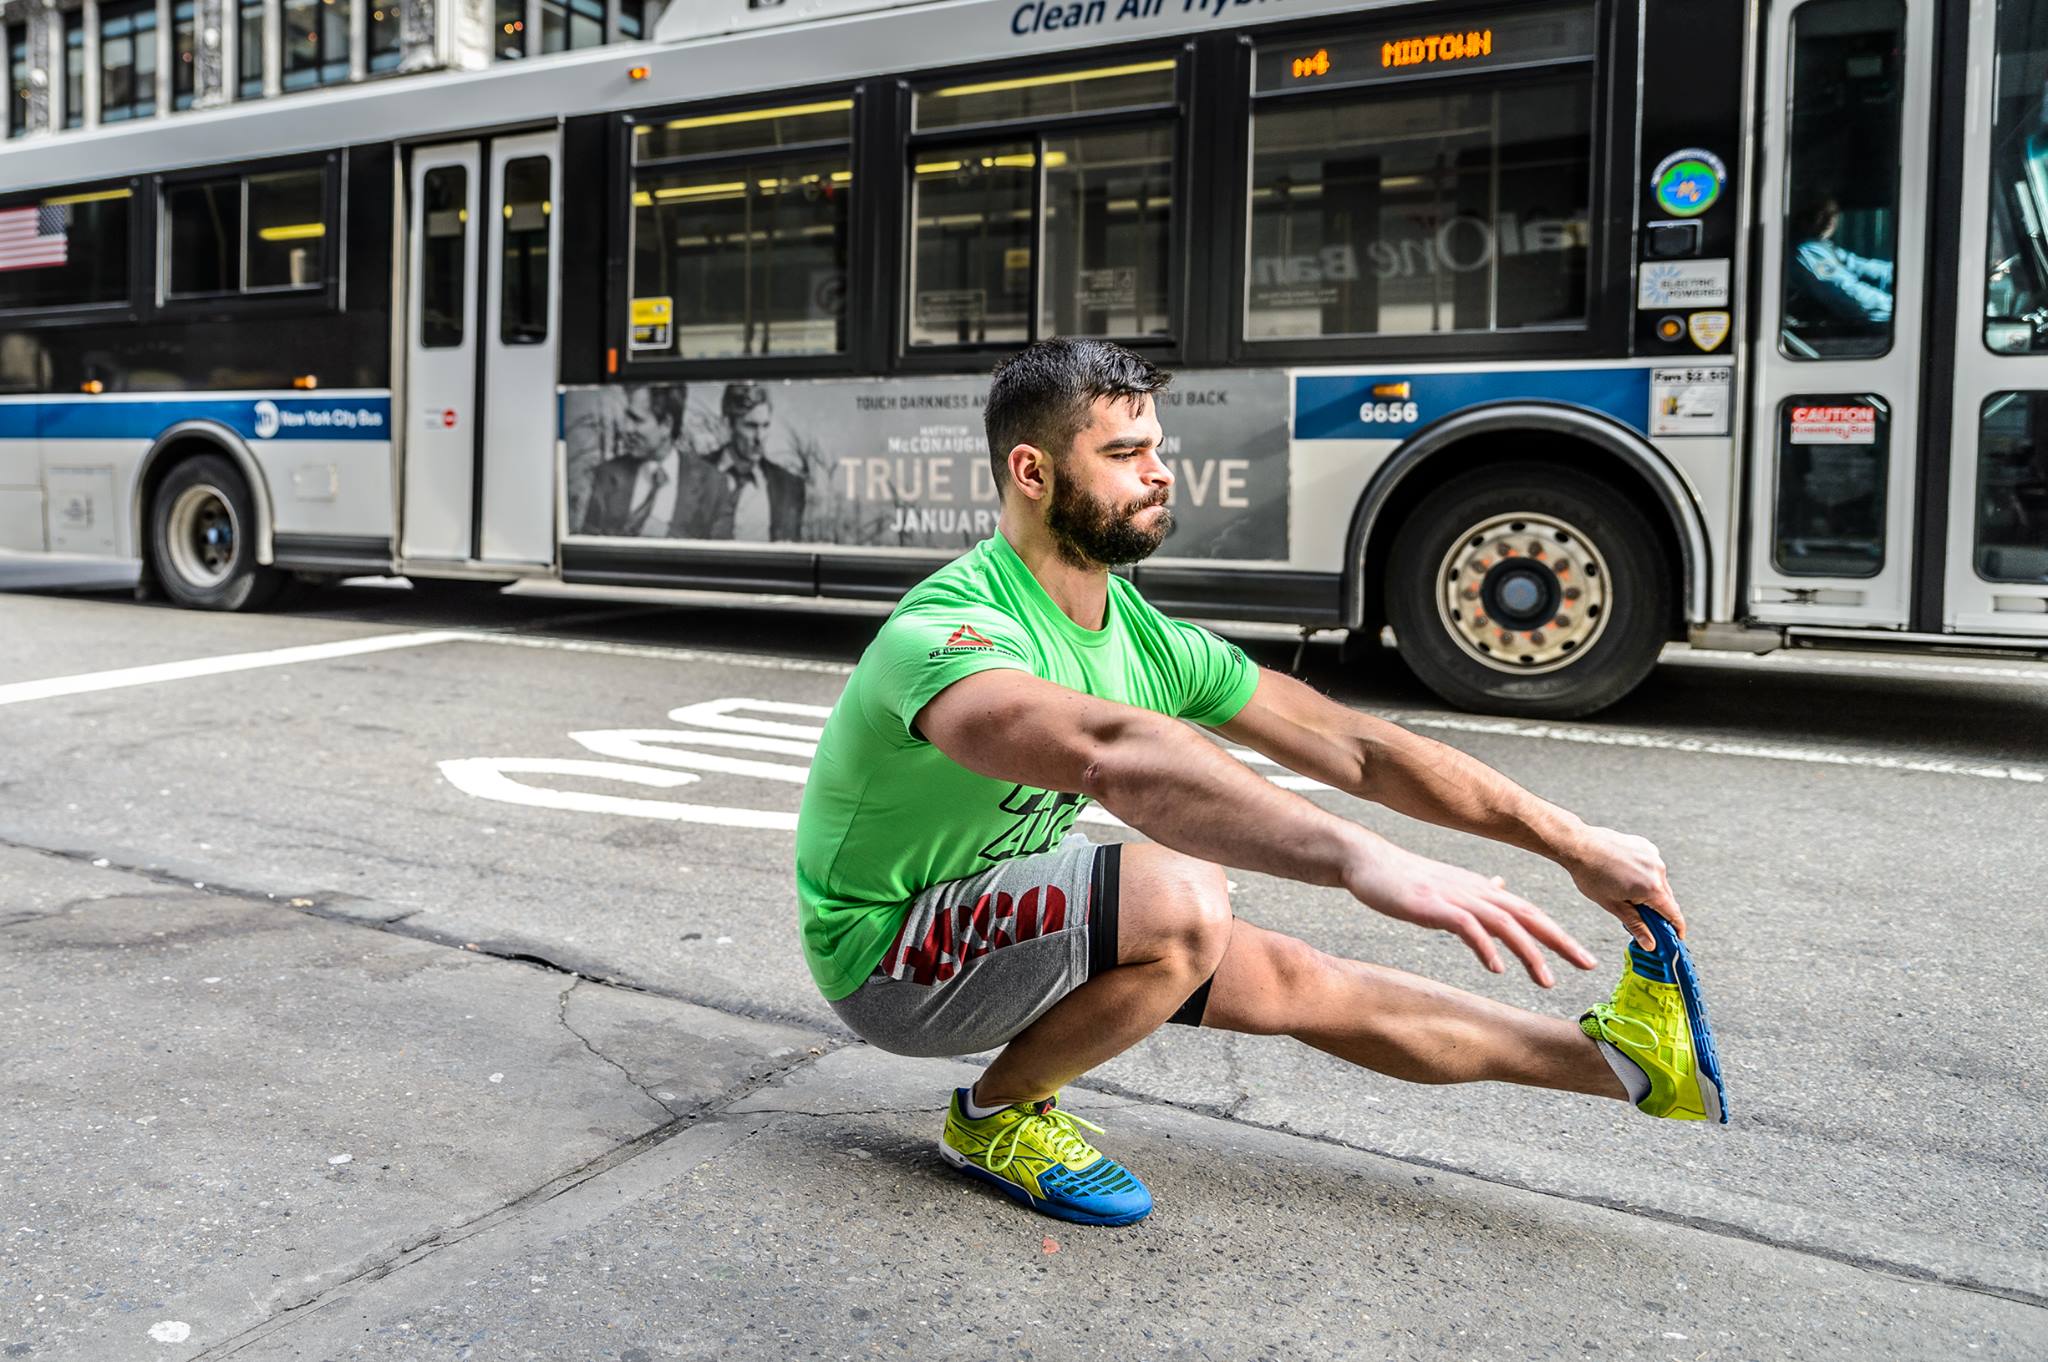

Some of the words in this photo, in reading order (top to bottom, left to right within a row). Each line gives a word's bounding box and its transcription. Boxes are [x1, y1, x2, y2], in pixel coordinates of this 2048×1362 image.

[1011, 0, 1104, 35] Clean
[1381, 29, 1492, 68] MIDTOWN
[900, 393, 969, 410] DARKNESS
[972, 393, 989, 408] AN
[1186, 390, 1228, 407] BACK
[1360, 402, 1418, 423] 6656
[1792, 407, 1874, 422] CAUTION
[887, 437, 989, 453] McCONAUGH
[840, 457, 954, 502] TRUE
